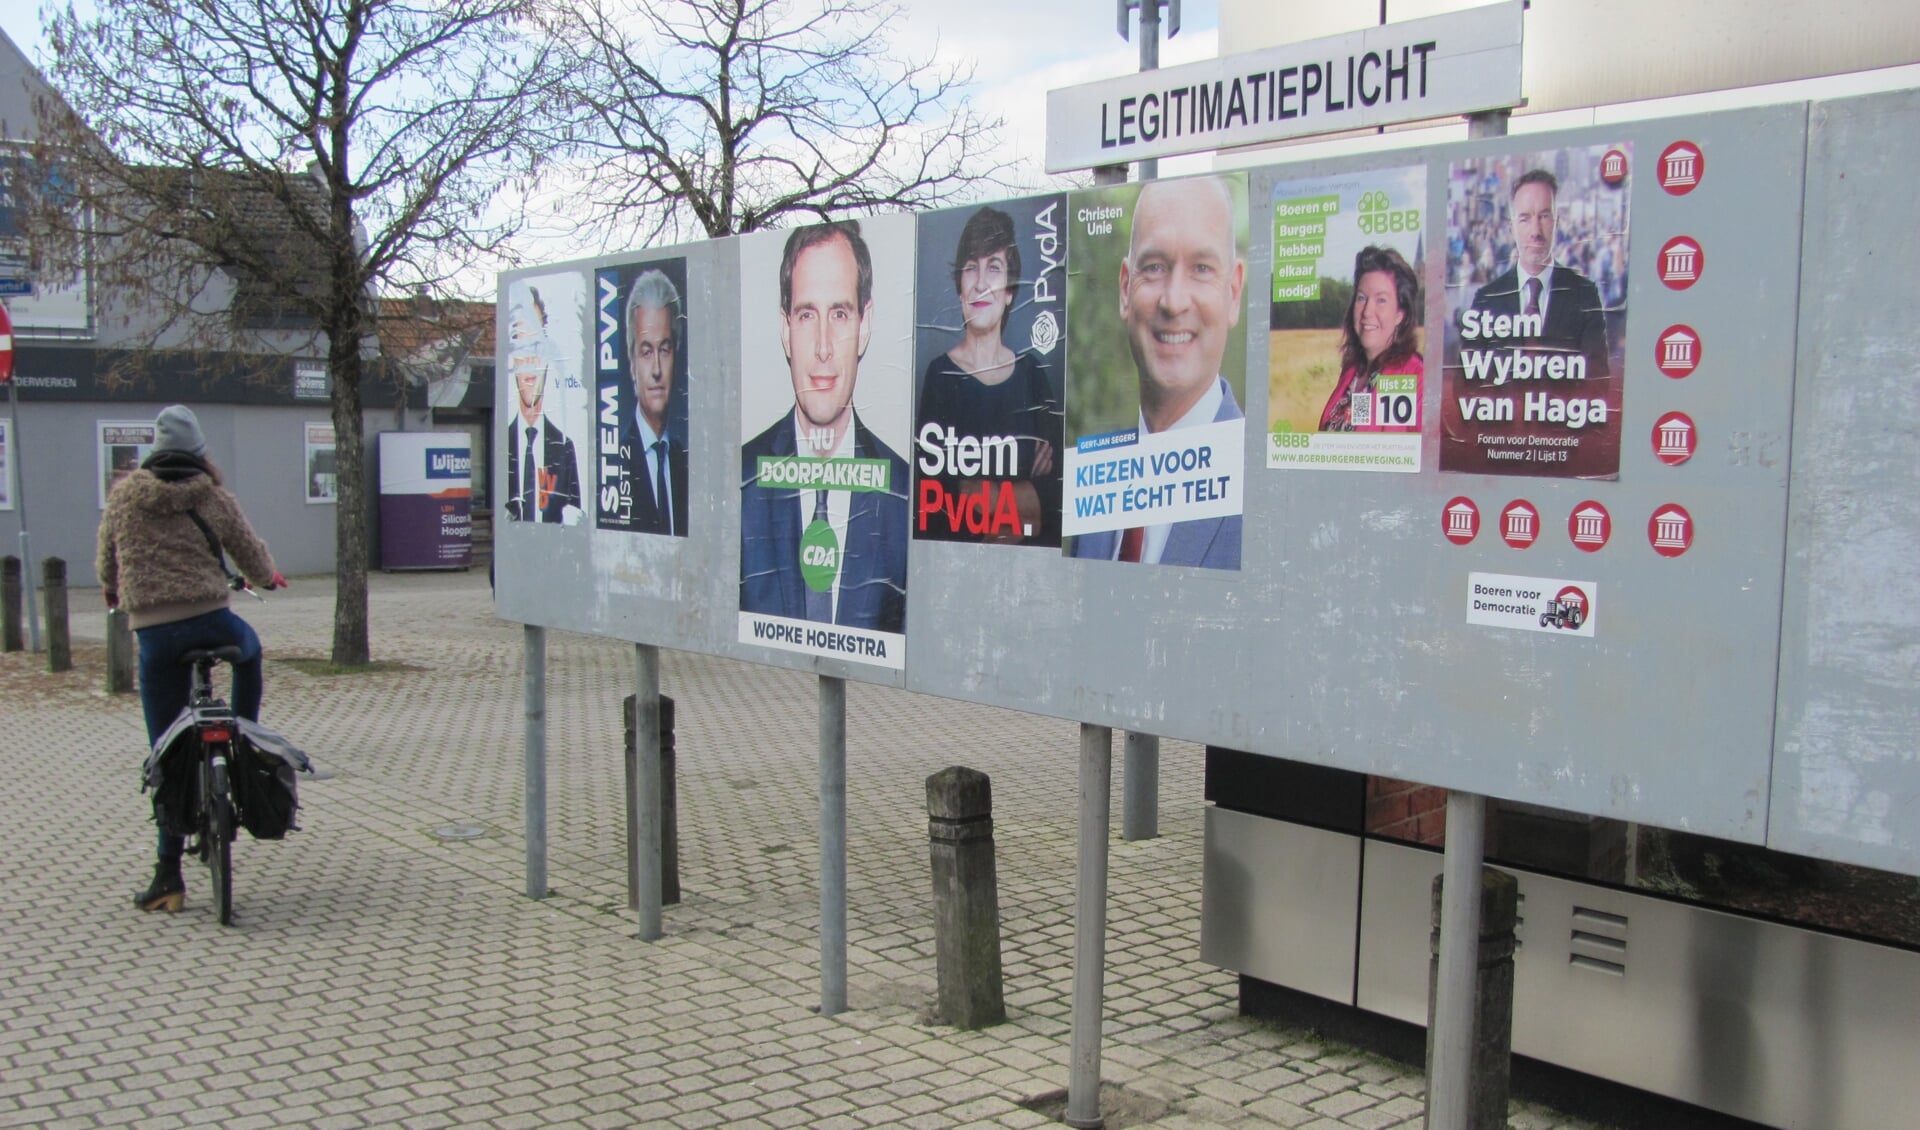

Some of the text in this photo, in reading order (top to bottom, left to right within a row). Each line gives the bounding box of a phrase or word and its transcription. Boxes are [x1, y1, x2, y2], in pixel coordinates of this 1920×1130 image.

[1101, 41, 1436, 149] LEGITIMATIEPLICHT
[1077, 206, 1123, 223] Christen
[1322, 201, 1337, 211] en
[1086, 221, 1113, 236] Unie
[1279, 225, 1324, 237] Burgers
[1375, 209, 1420, 234] BBB
[1034, 202, 1058, 302] PvdA
[1279, 244, 1322, 257] hebben
[1278, 264, 1314, 277] elkaar
[600, 277, 619, 370] PVV
[1461, 310, 1541, 339] Stem
[1460, 349, 1586, 386] Wybren
[1379, 377, 1415, 391] lijst 23
[1379, 395, 1412, 424] 10
[1458, 392, 1607, 428] van Haga
[601, 386, 619, 513] STEM
[808, 428, 834, 450] NU
[918, 422, 1018, 477] Stem
[1080, 432, 1137, 450] GERT-JAN SEGERS
[1477, 434, 1579, 447] Forum voor Democratie
[620, 445, 631, 459] 2
[1272, 454, 1416, 466] WWW.BOERBURGERBEWEGING.NL
[1487, 449, 1524, 461] Nummer
[1525, 450, 1531, 461] 2
[1538, 450, 1556, 462] Lijst
[1558, 451, 1567, 462] 13
[761, 461, 886, 488] DOORPAKKEN
[1076, 446, 1212, 488] KIEZEN VOOR
[1075, 475, 1230, 518] WAT ÉCHT TELT
[803, 545, 835, 568] CDA
[1474, 584, 1541, 600] Boeren voor
[1473, 600, 1536, 616] Democratie
[753, 621, 887, 658] WOPKE HOEKSTRA
